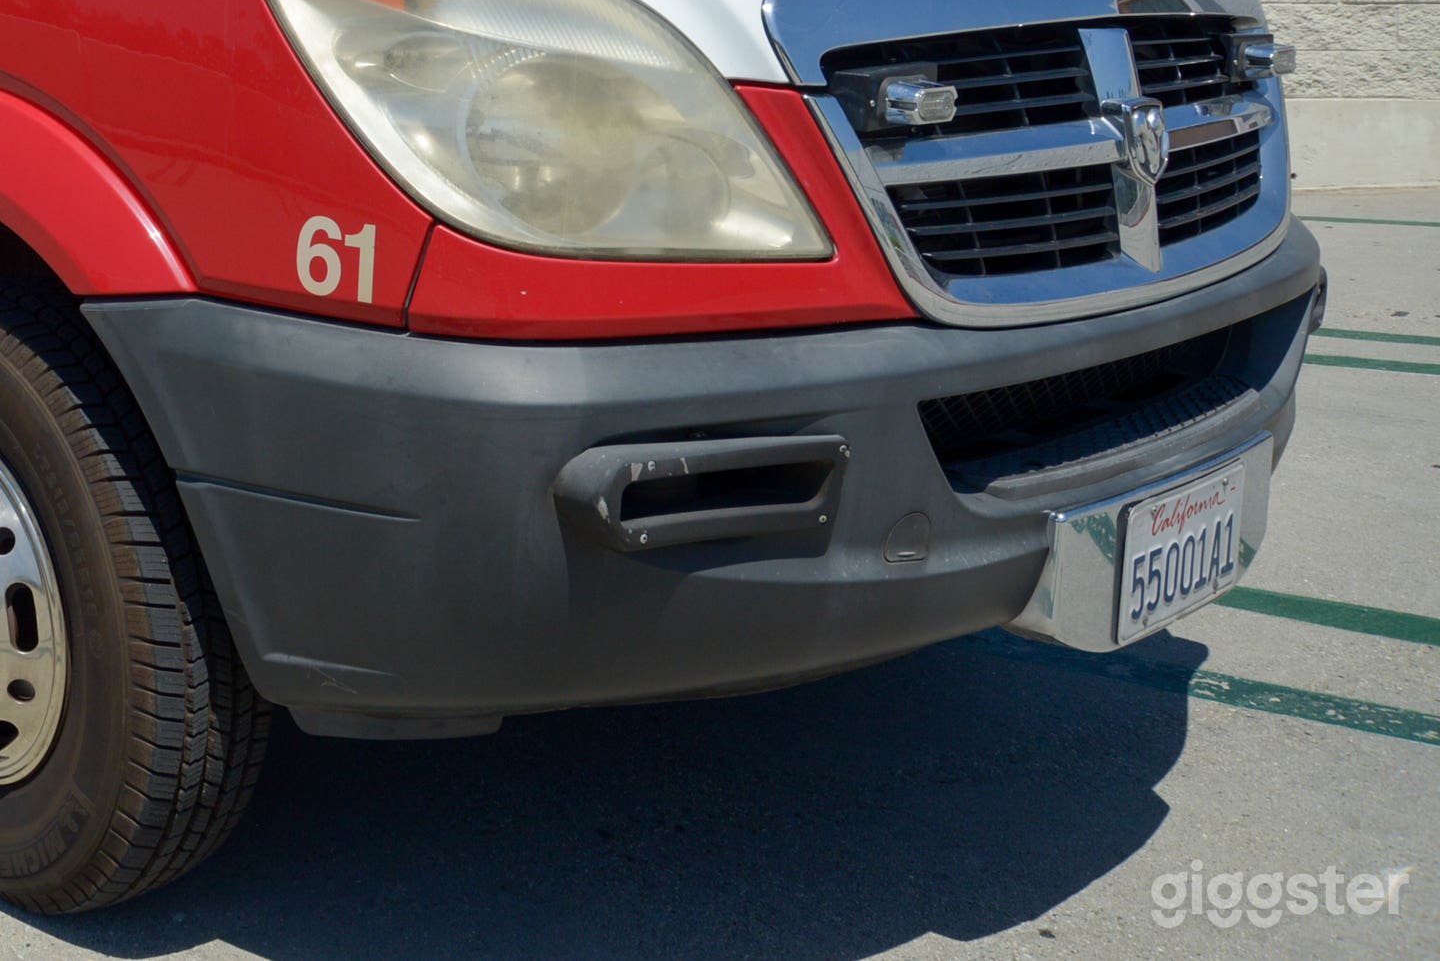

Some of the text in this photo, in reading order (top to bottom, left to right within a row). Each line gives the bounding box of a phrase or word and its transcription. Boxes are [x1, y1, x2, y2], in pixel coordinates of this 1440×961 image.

[296, 215, 376, 304] 61
[1152, 491, 1225, 536] California
[1131, 513, 1234, 620] 55001A1
